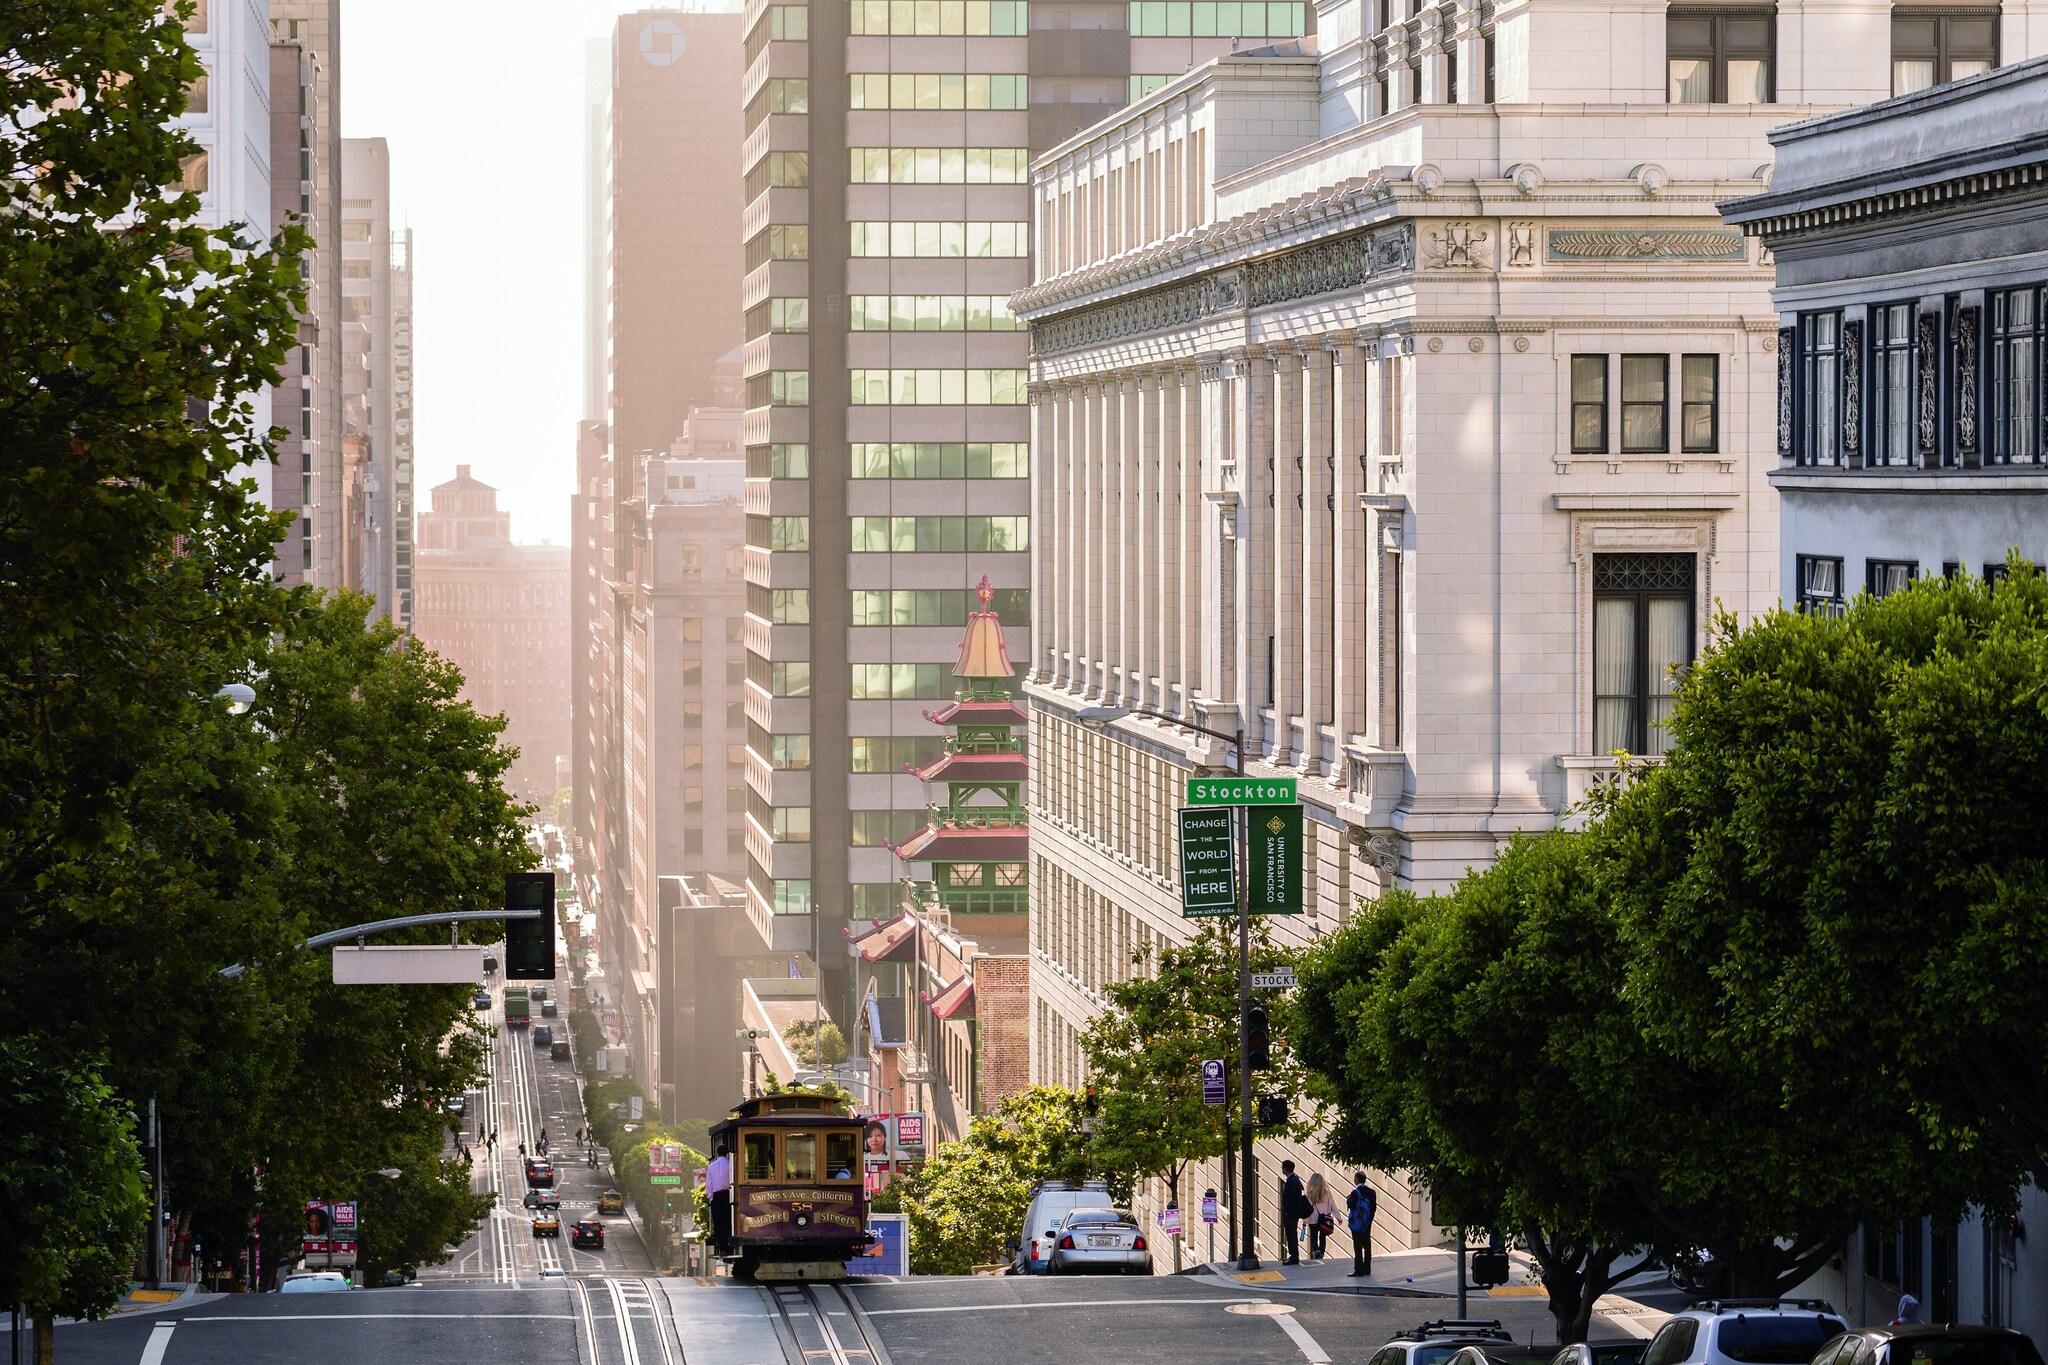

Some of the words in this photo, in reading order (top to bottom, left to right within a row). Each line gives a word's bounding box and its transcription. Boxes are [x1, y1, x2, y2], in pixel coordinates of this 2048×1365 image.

[1196, 785, 1289, 798] Stockton
[1184, 819, 1228, 829] CHANGE
[1266, 837, 1275, 854] SAN
[1186, 850, 1228, 860] WORLD
[1277, 837, 1285, 889] UNIVERSITY
[1266, 856, 1275, 903] FRANCISCO
[1190, 881, 1228, 895] HERE
[1277, 892, 1285, 903] OF
[1254, 976, 1297, 985] STOCKT
[900, 1119, 920, 1127] AIDS
[900, 1127, 920, 1135] WALK
[767, 1192, 787, 1200] Ness
[811, 1191, 853, 1201] California
[792, 1202, 813, 1211] 58
[756, 1211, 786, 1225] Market
[821, 1212, 855, 1225] Streets
